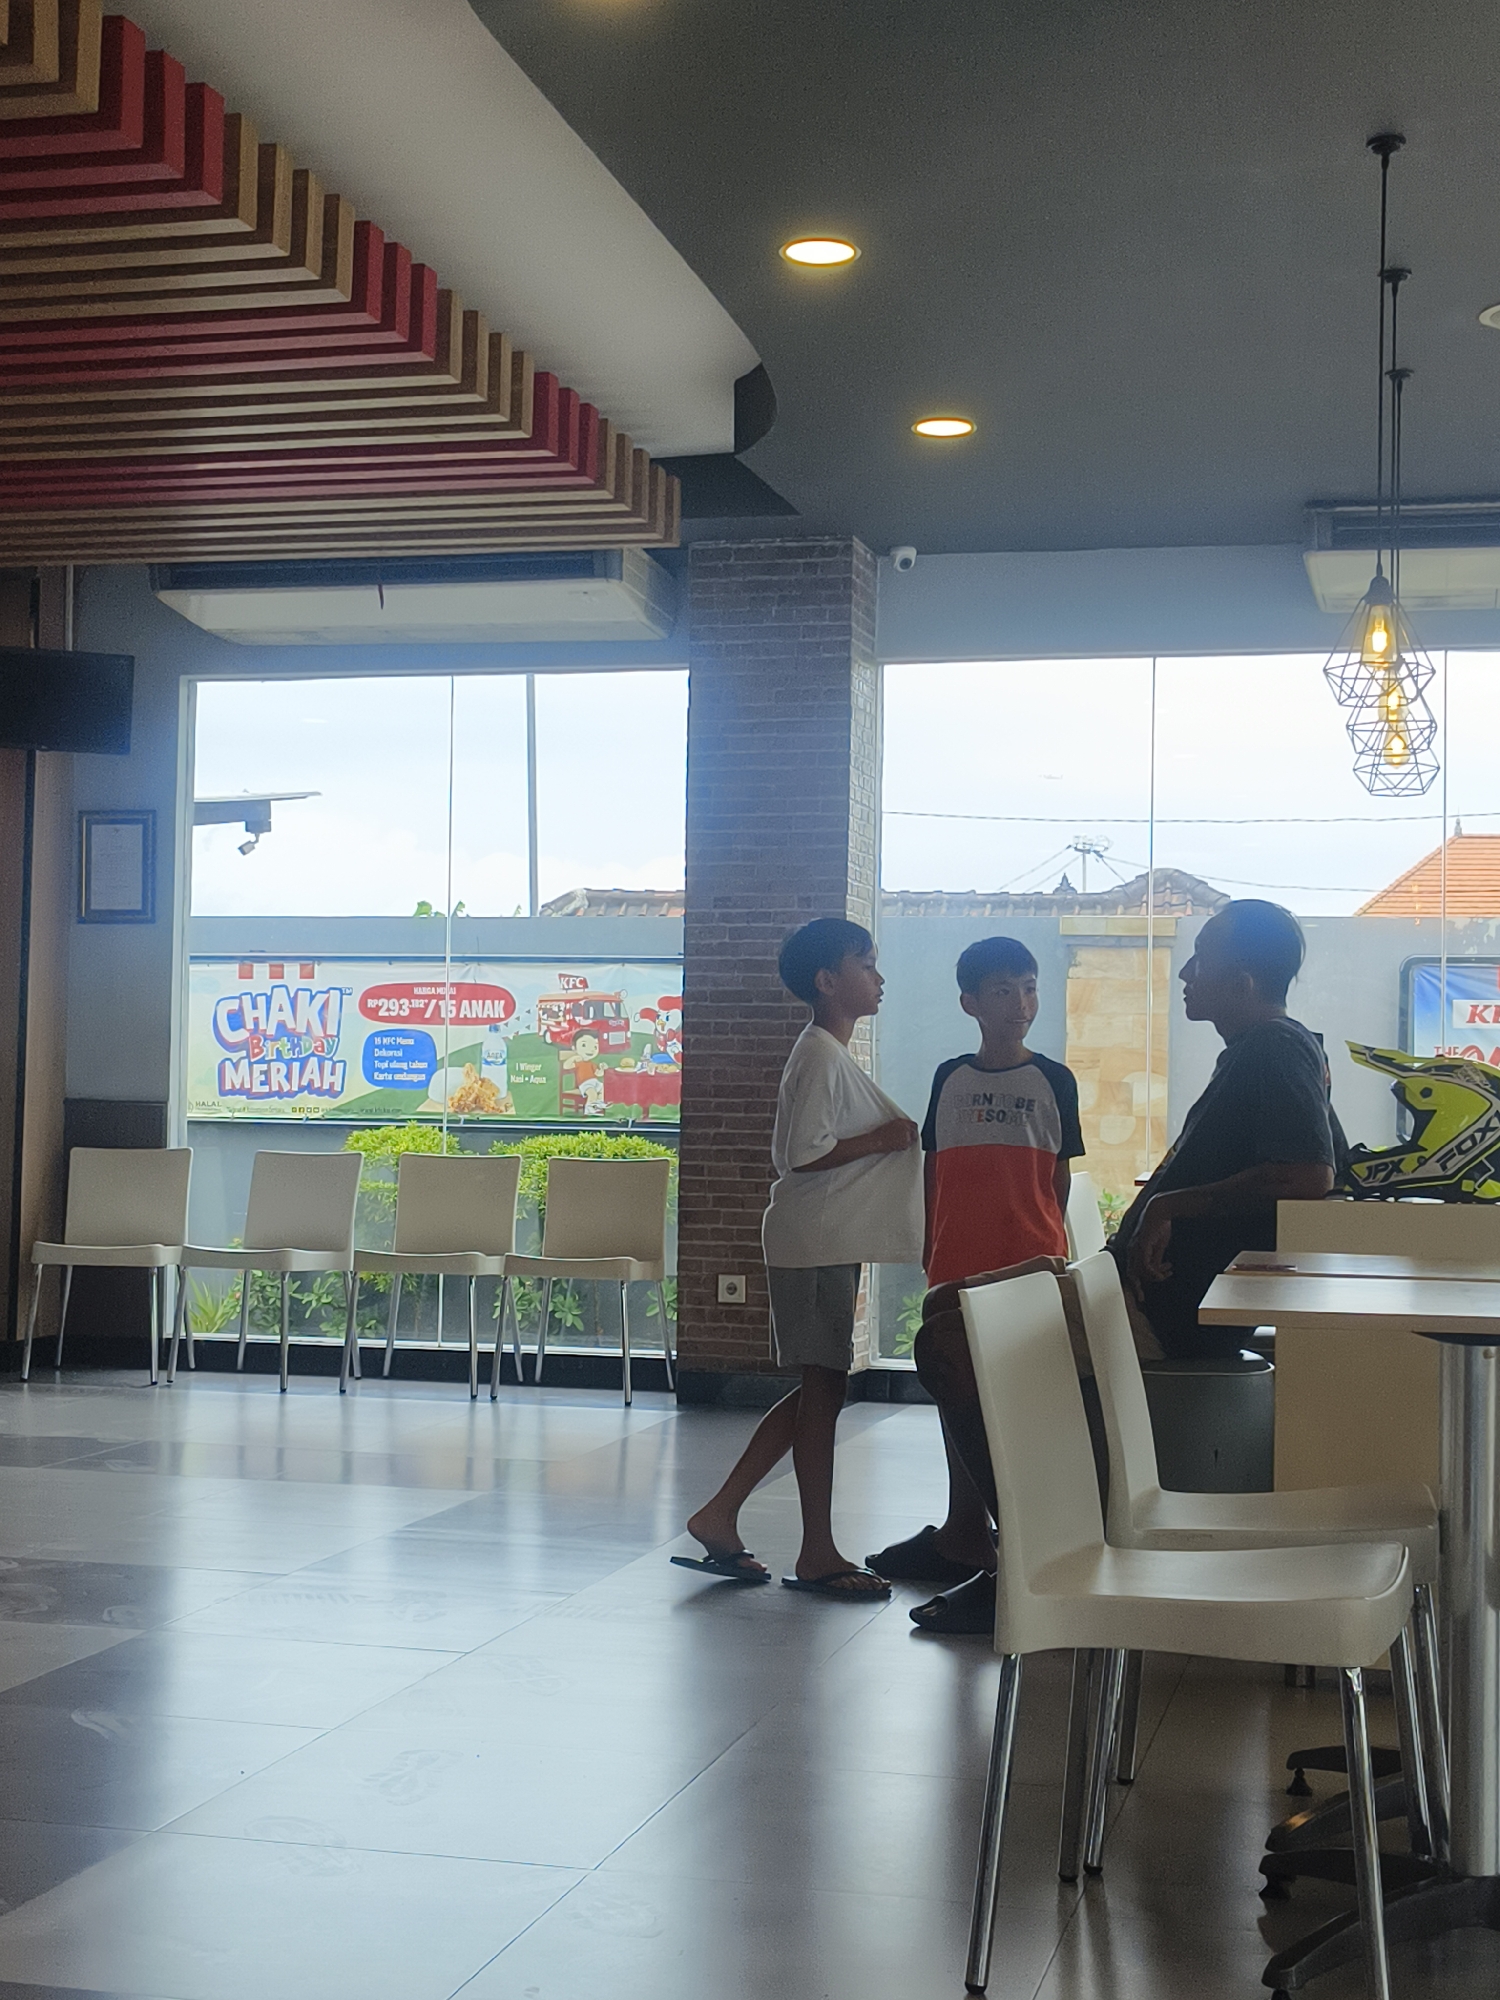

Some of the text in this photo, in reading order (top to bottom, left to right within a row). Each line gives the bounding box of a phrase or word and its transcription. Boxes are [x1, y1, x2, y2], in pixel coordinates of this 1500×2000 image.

[560, 977, 584, 989] KFC
[214, 985, 342, 1045] CHAKI
[459, 999, 505, 1018] ANAK
[1466, 1004, 1500, 1024] K
[223, 1056, 346, 1094] MERIAH
[1360, 1157, 1406, 1185] JPX
